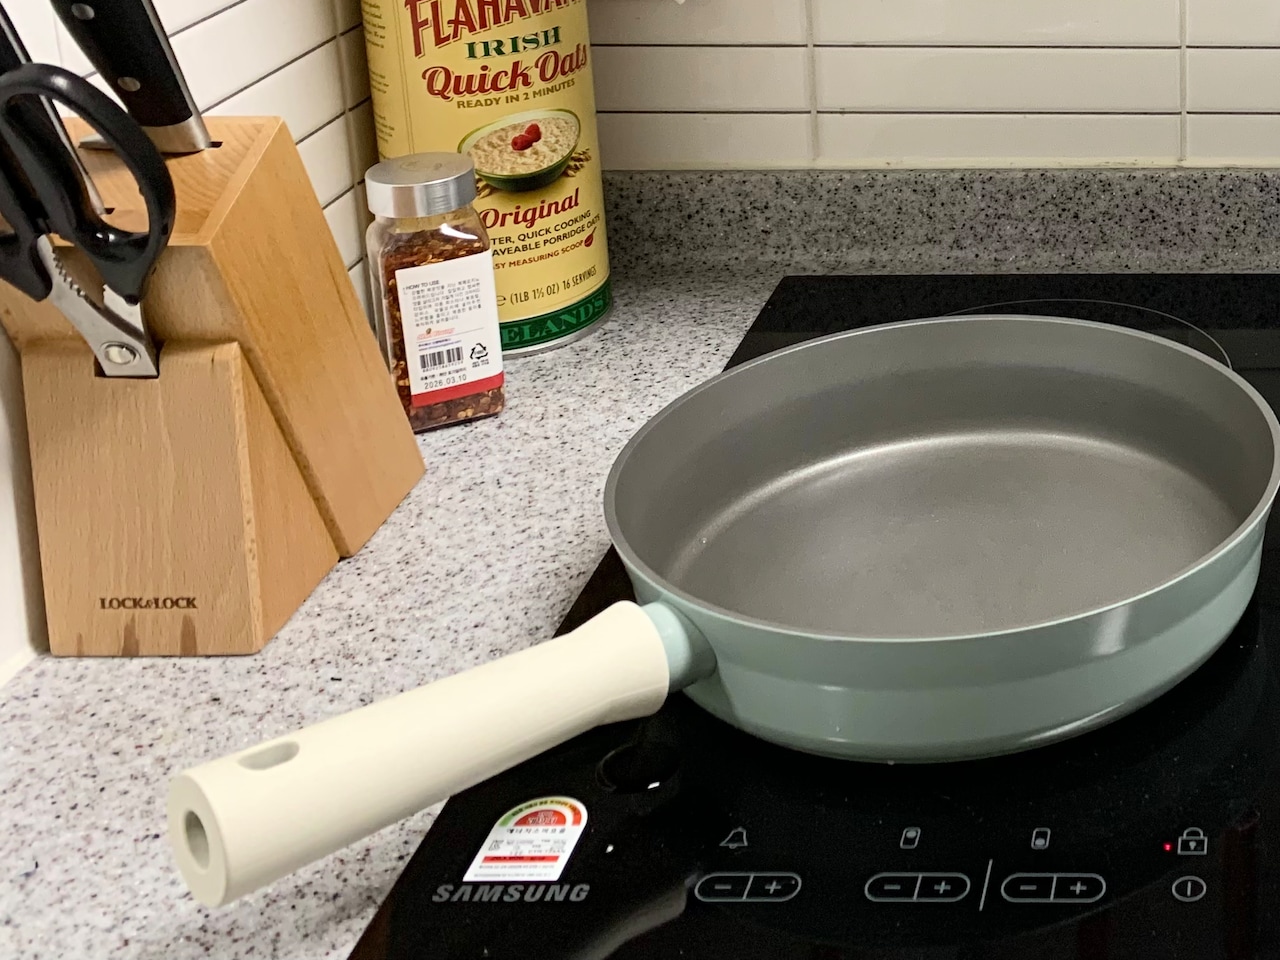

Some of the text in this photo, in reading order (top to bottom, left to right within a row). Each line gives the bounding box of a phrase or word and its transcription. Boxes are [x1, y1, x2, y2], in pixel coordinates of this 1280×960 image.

[464, 26, 562, 59] IRISH
[421, 60, 533, 101] Quick
[534, 43, 588, 83] Oats
[456, 78, 576, 109] READY IN 2 MINUTES
[478, 187, 580, 229] Original
[492, 242, 541, 257] AVEABLE
[543, 224, 586, 247] PORRIDGE
[517, 227, 552, 242] QUICK
[554, 209, 592, 232] COOKING
[508, 249, 560, 268] MEASURING
[561, 239, 584, 254] SCOOP
[546, 282, 560, 296] OZ)
[562, 279, 571, 290] 16
[572, 264, 597, 287] SERVINGS
[501, 298, 604, 344] ELAND'S
[432, 883, 591, 903] SAMSUNG
